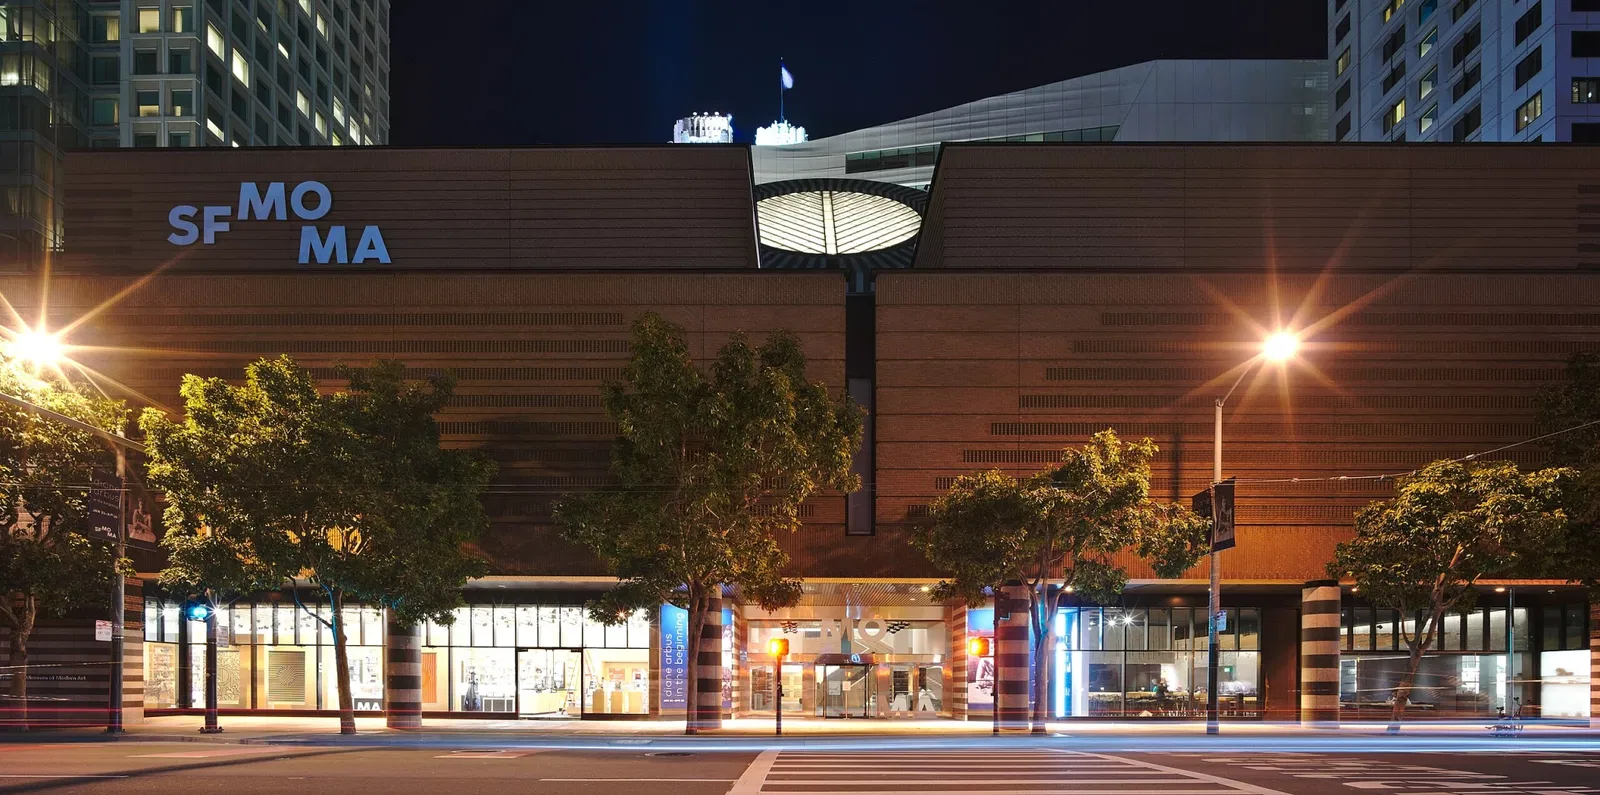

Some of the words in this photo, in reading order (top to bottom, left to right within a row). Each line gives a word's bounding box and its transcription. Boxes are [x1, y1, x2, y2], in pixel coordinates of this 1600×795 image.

[167, 205, 232, 246] SF
[298, 225, 392, 264] MA
[93, 490, 119, 501] arbus
[664, 633, 673, 665] arbus
[674, 612, 686, 665] beginning
[664, 667, 673, 697] diane
[675, 667, 683, 685] the
[675, 687, 683, 697] in
